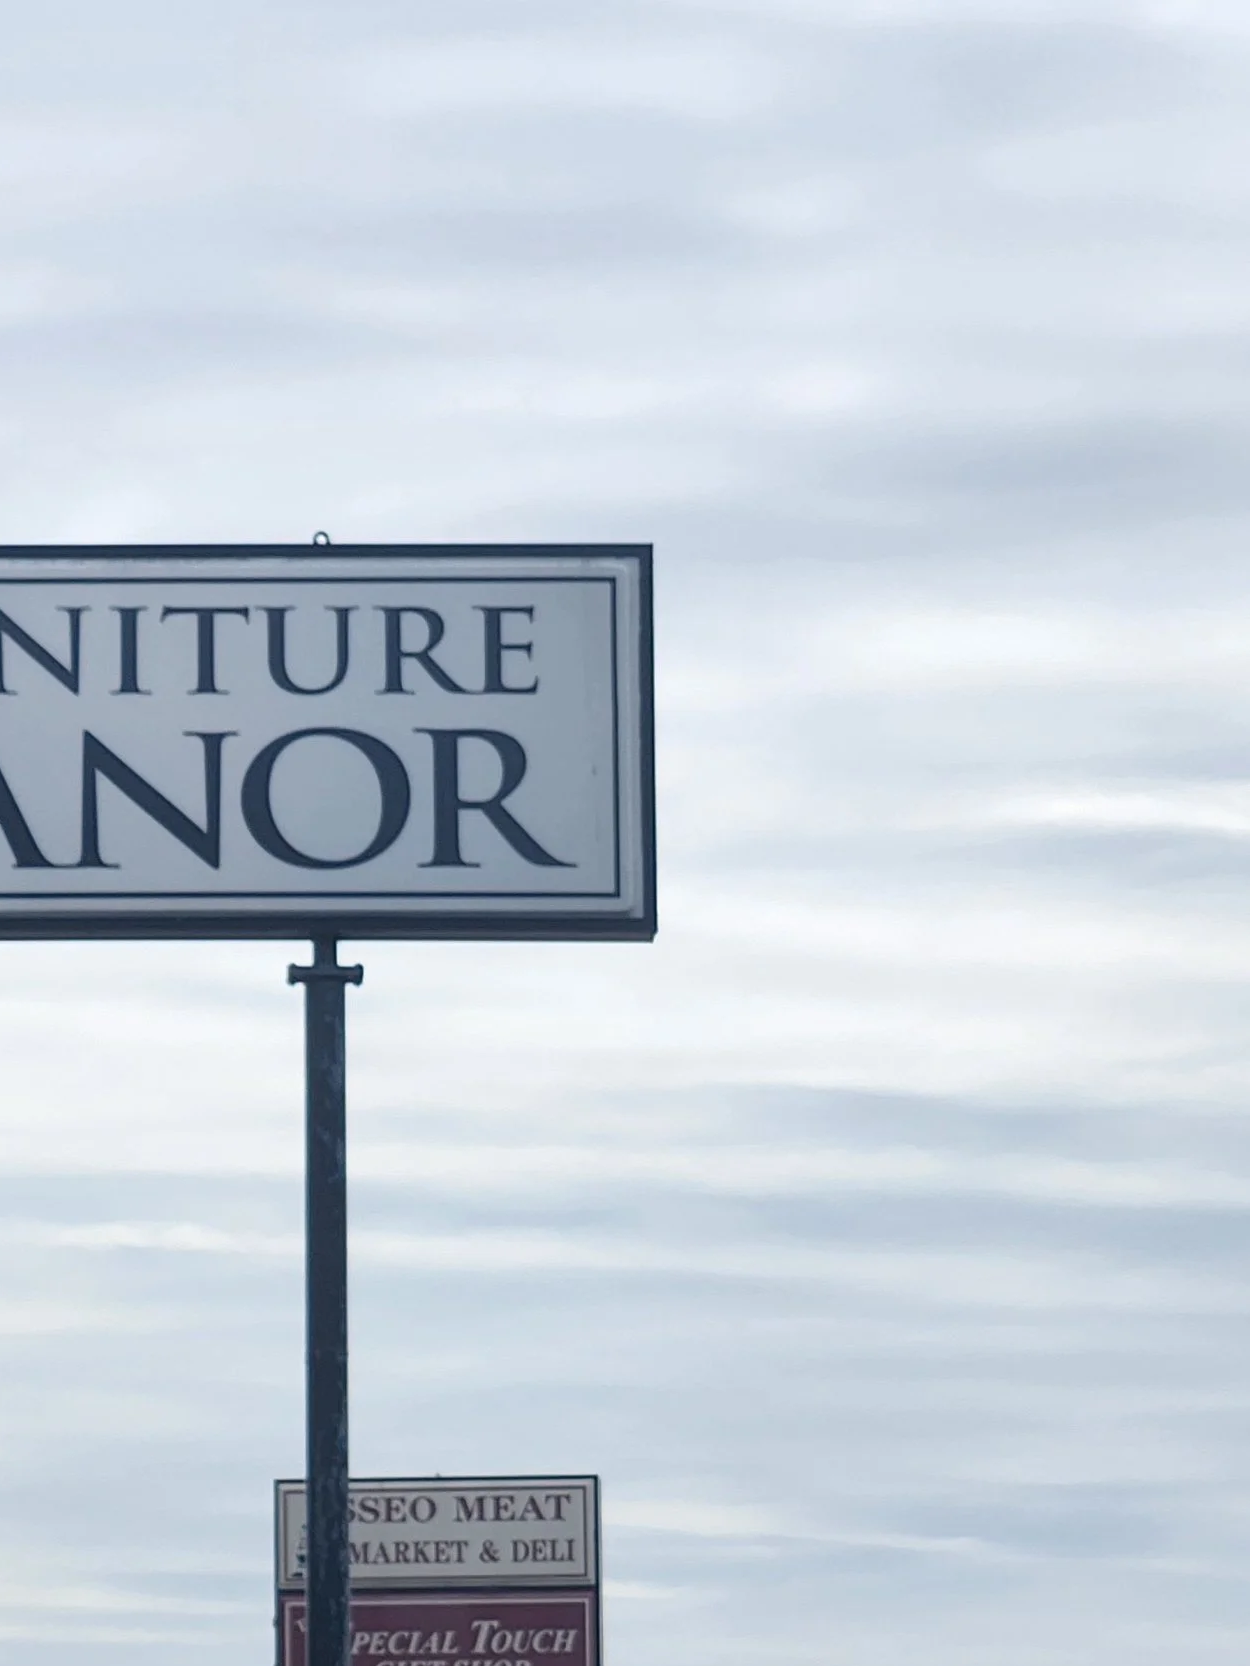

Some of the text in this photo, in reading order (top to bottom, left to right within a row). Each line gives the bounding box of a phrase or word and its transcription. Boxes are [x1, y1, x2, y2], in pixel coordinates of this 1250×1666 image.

[453, 1493, 572, 1523] MEAT
[349, 1538, 577, 1566] MARKET & DELI
[349, 1619, 459, 1656] PECIAL
[470, 1619, 579, 1655] TOUCH
